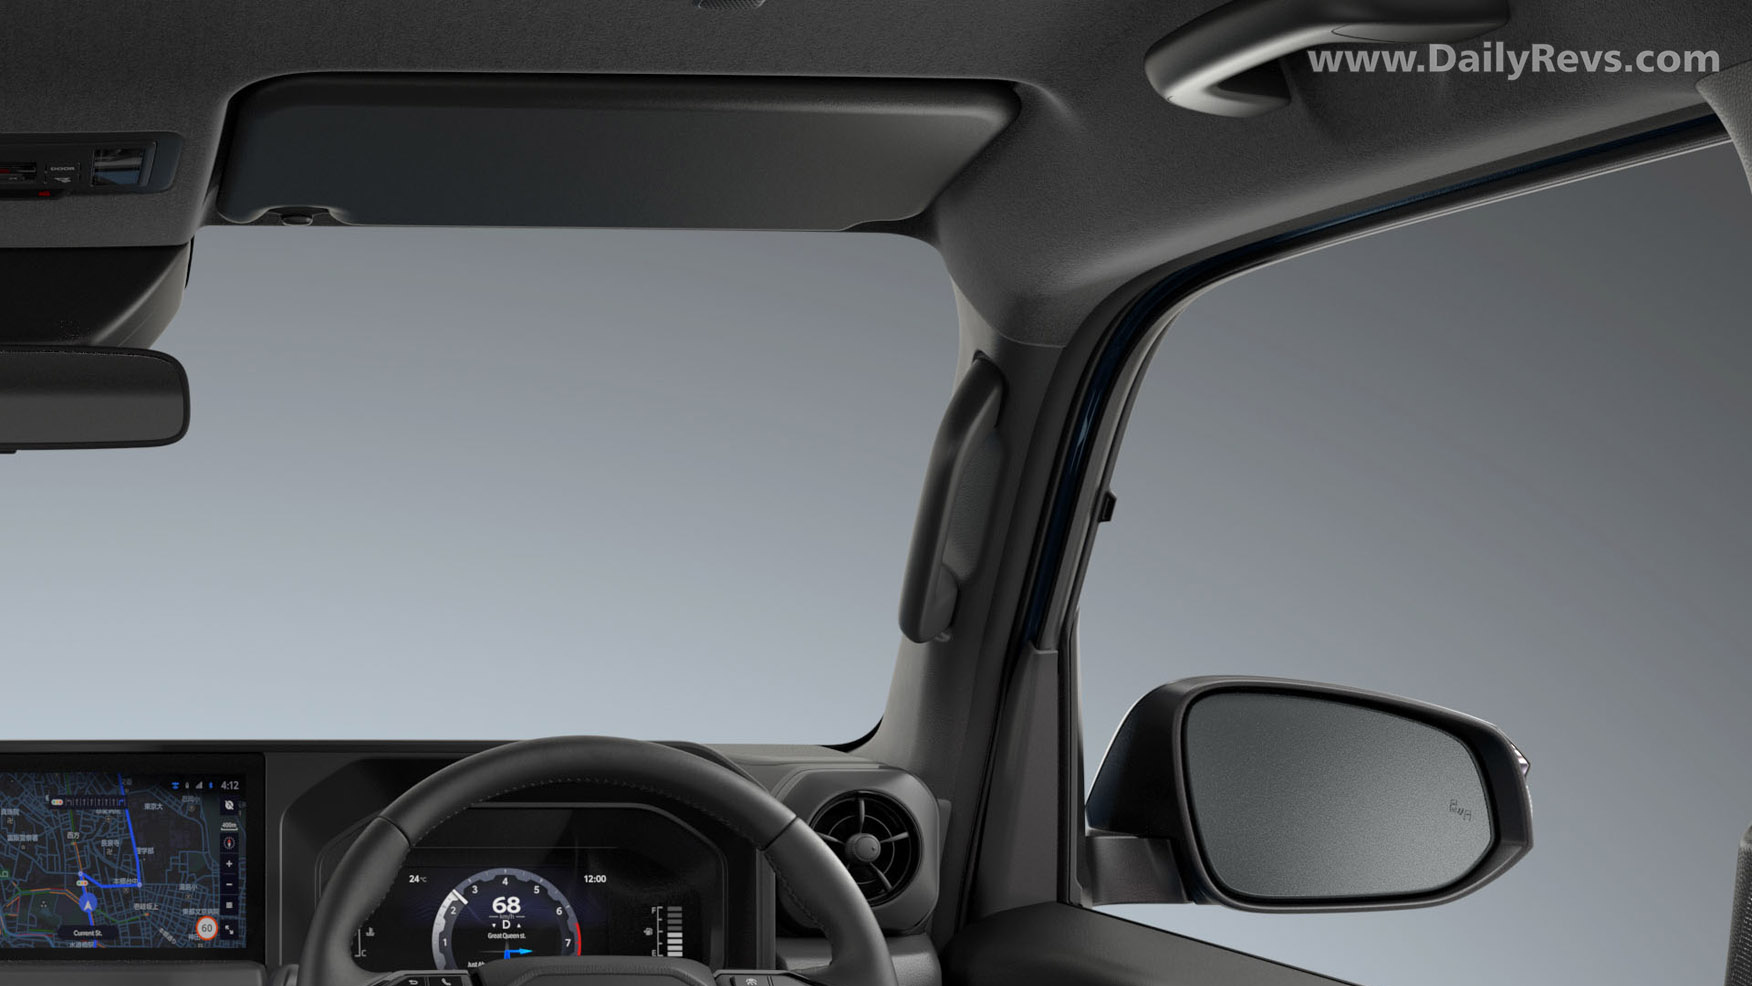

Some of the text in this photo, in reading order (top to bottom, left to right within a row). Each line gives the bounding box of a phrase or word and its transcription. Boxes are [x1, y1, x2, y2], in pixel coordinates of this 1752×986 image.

[220, 781, 240, 790] 4:12
[502, 877, 509, 886] 4
[583, 874, 607, 883] 12:00
[471, 885, 478, 894] 3
[533, 885, 540, 894] 5
[491, 895, 522, 914] 68
[450, 906, 457, 915] 2
[556, 907, 563, 916] 6
[201, 923, 213, 932] 60
[502, 920, 511, 929] D
[73, 929, 93, 937] Current
[502, 932, 520, 940] Queen
[442, 938, 448, 946] 1
[565, 938, 572, 948] 7
[360, 949, 367, 957] C
